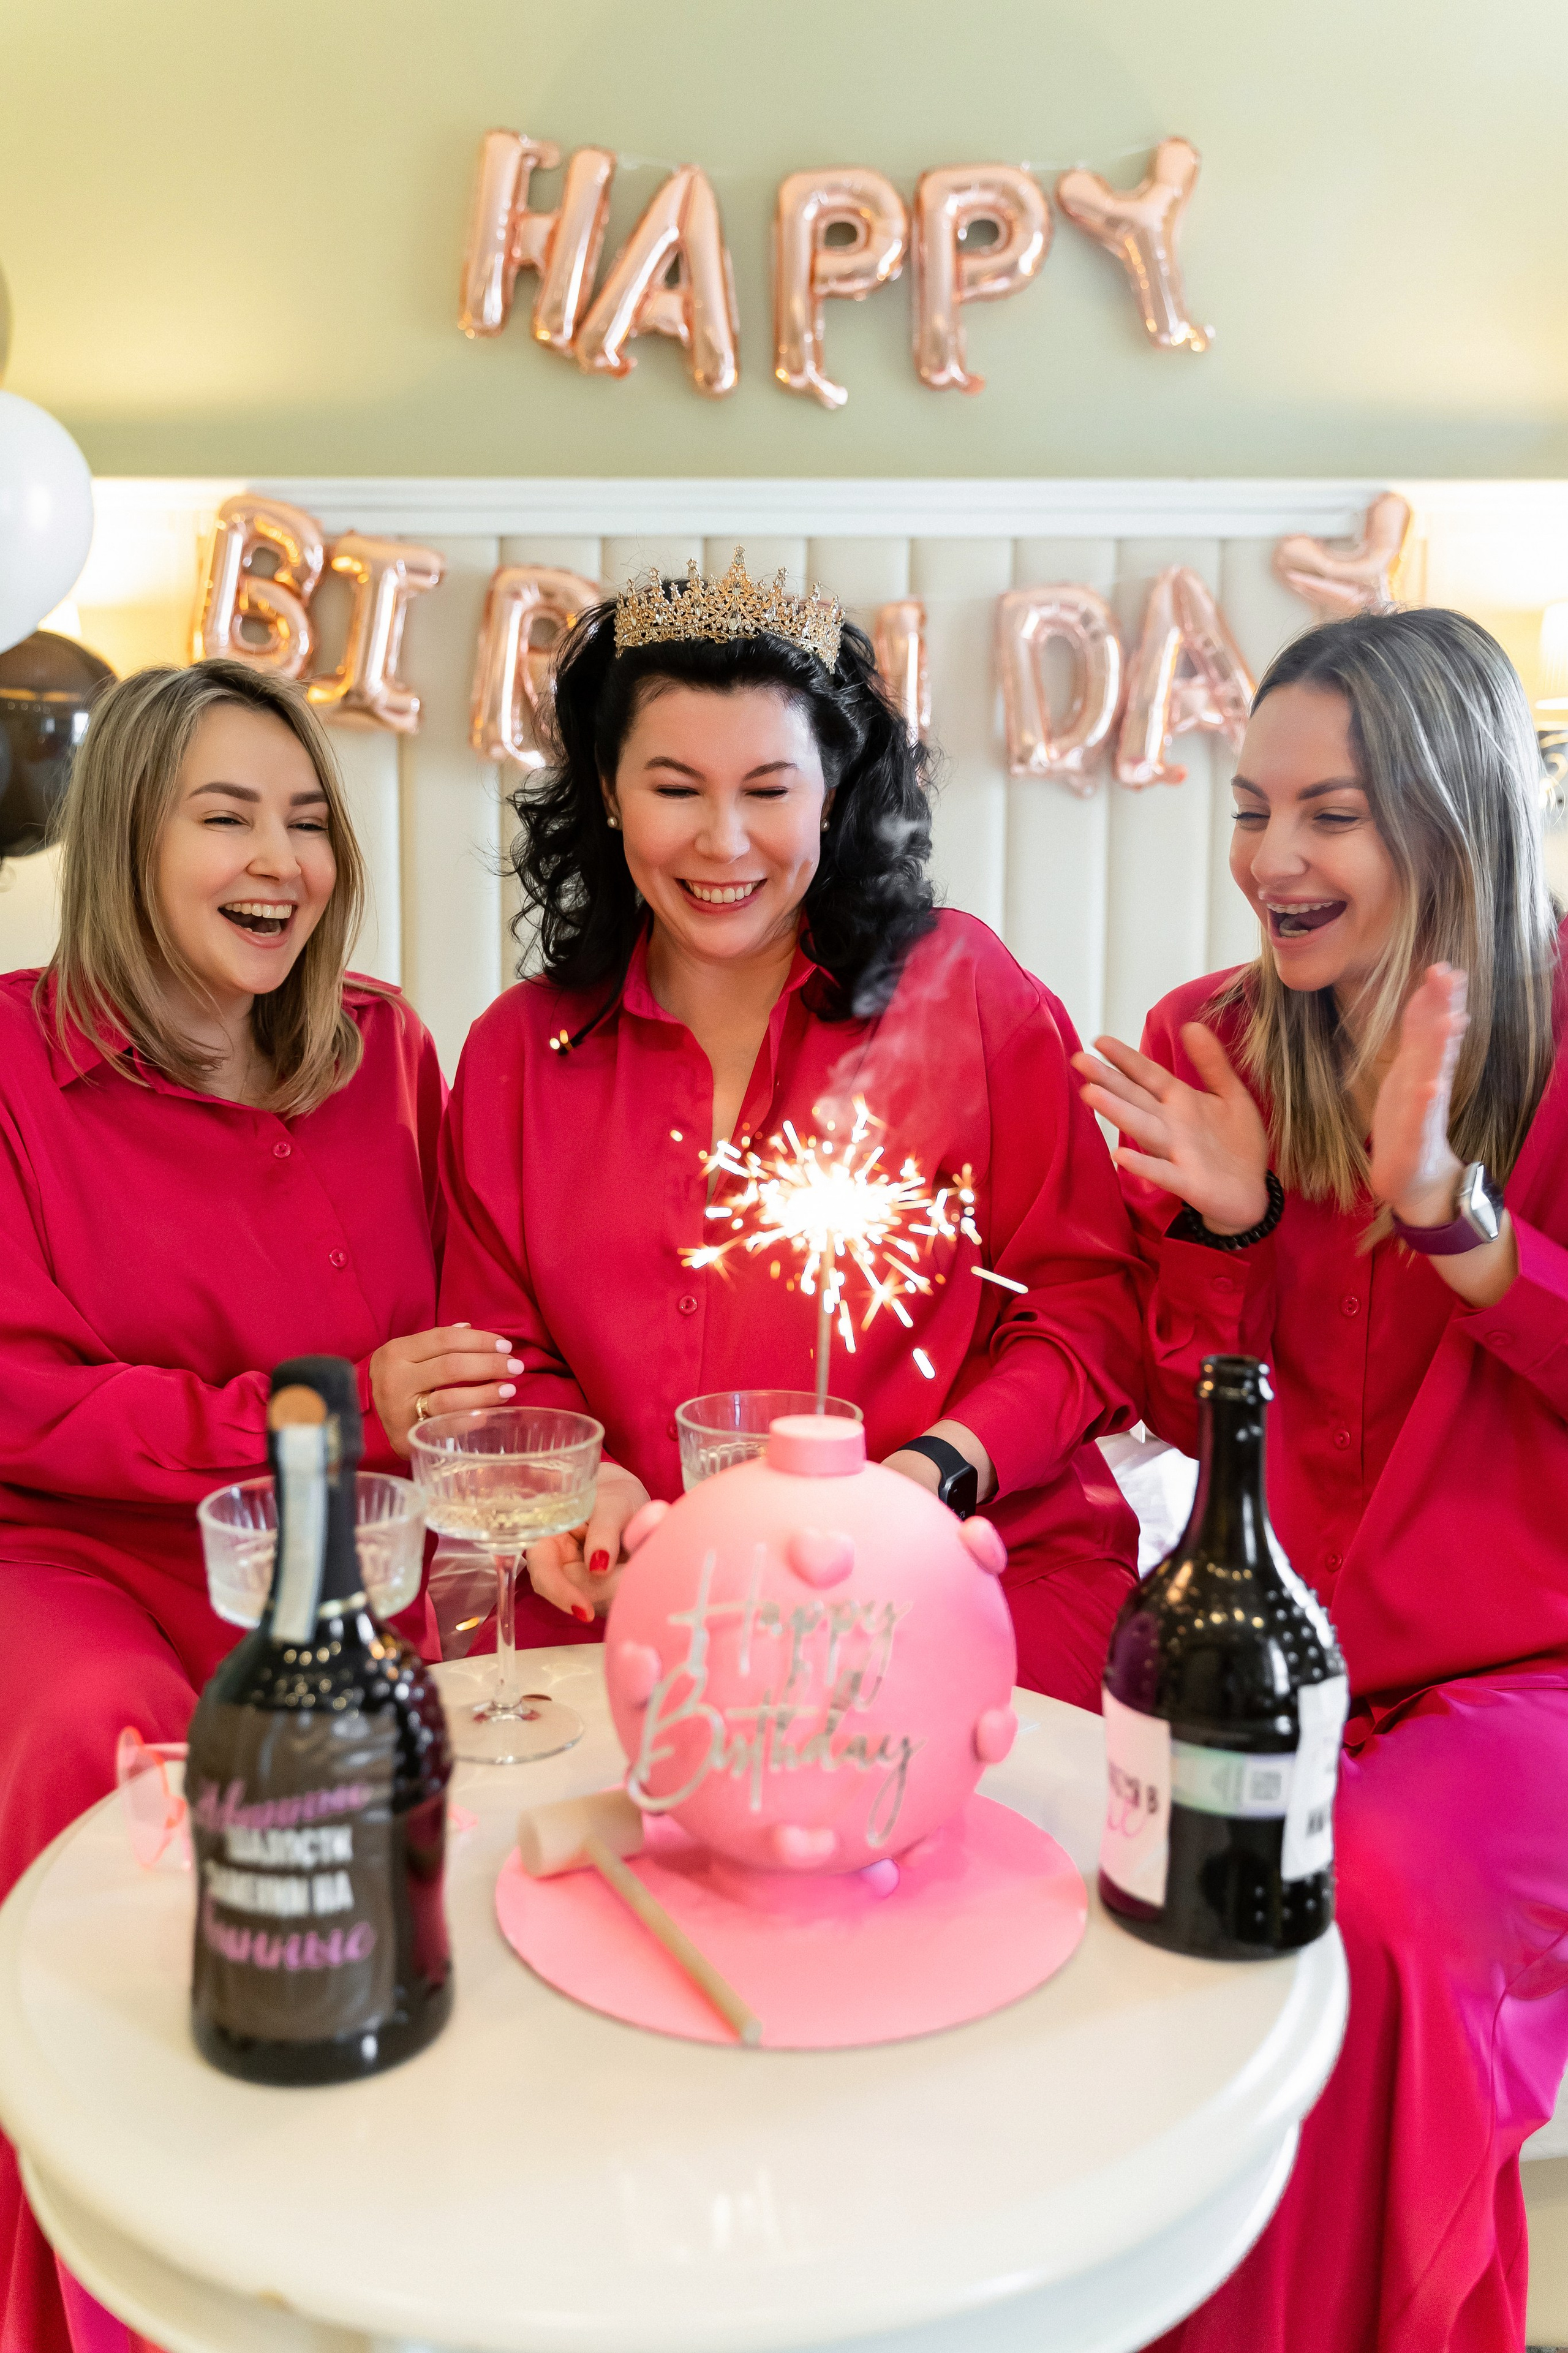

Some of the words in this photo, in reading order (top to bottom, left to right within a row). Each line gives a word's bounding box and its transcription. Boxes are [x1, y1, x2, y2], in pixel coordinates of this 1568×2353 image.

[458, 127, 1216, 409] HAPPY
[668, 1543, 914, 1712] Happy
[627, 1659, 929, 1848] Birthday
